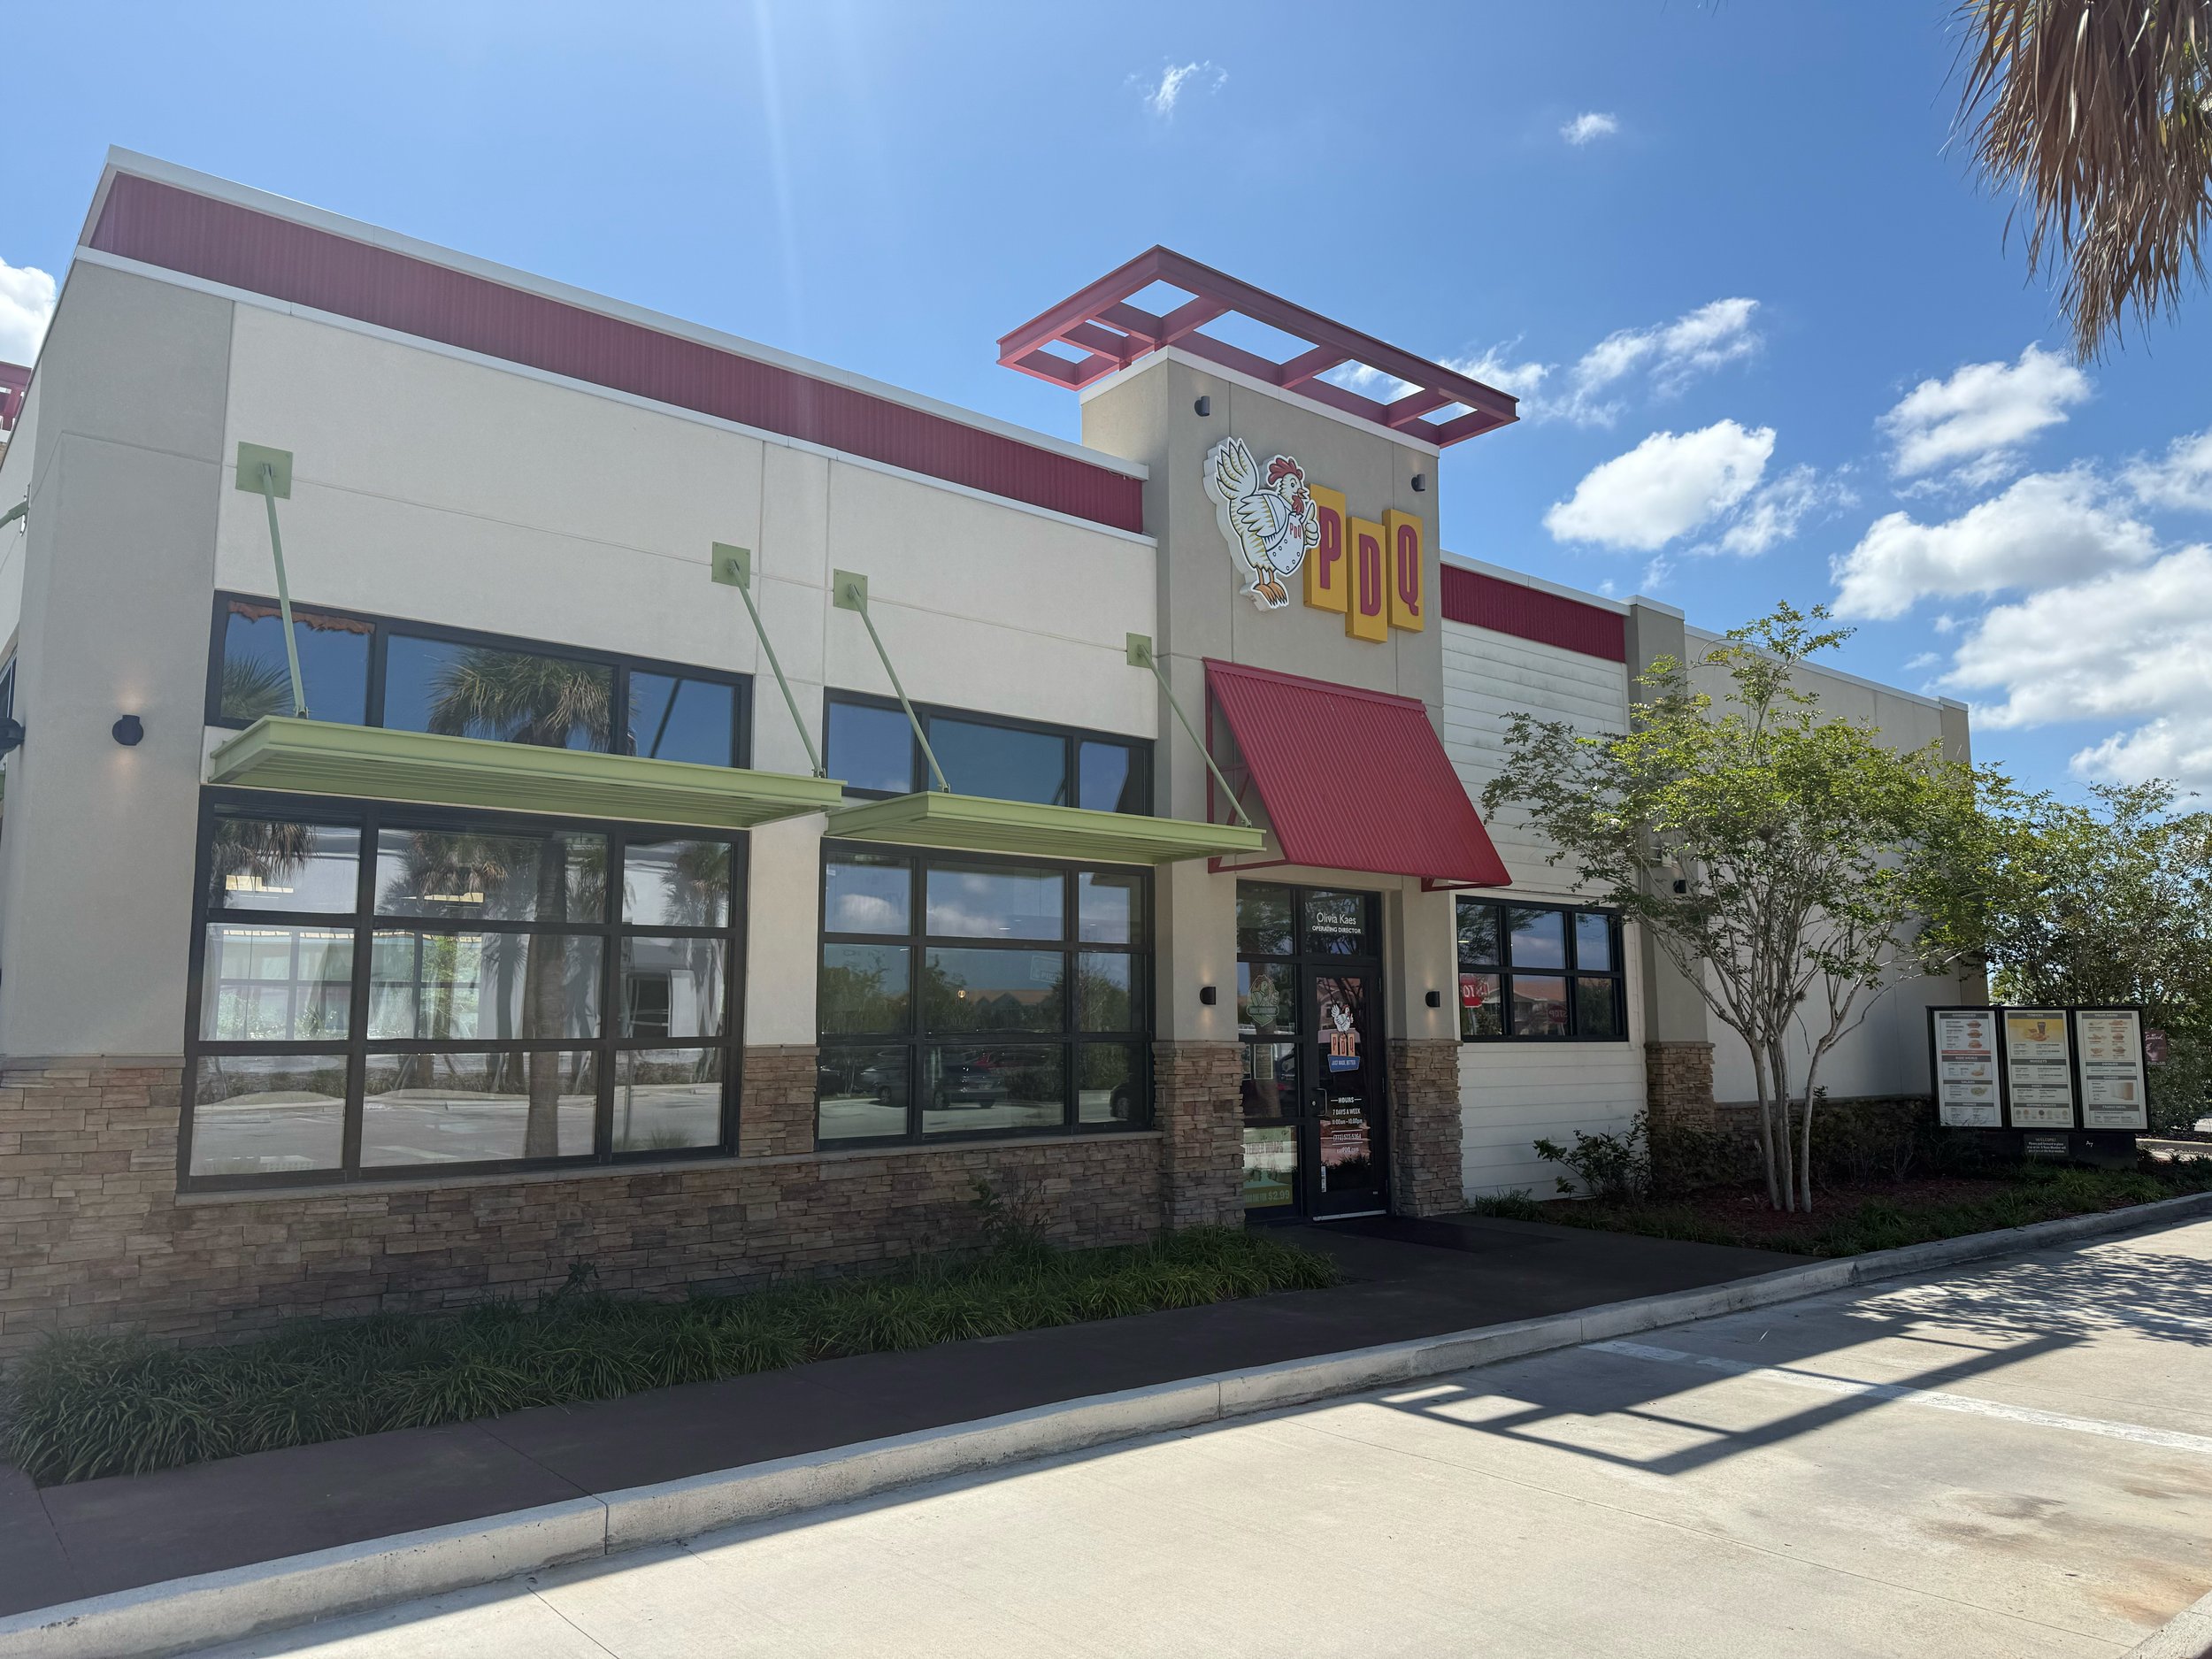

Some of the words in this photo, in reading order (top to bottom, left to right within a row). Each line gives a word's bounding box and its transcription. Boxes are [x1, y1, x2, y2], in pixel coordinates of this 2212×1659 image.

[1290, 523, 1302, 540] PDQ
[1319, 505, 1419, 617] PDQ
[1317, 911, 1338, 924] Olivia
[1339, 913, 1356, 926] Kaes
[1333, 1036, 1354, 1055] PDQ
[1267, 1189, 1290, 1202] $2.99
